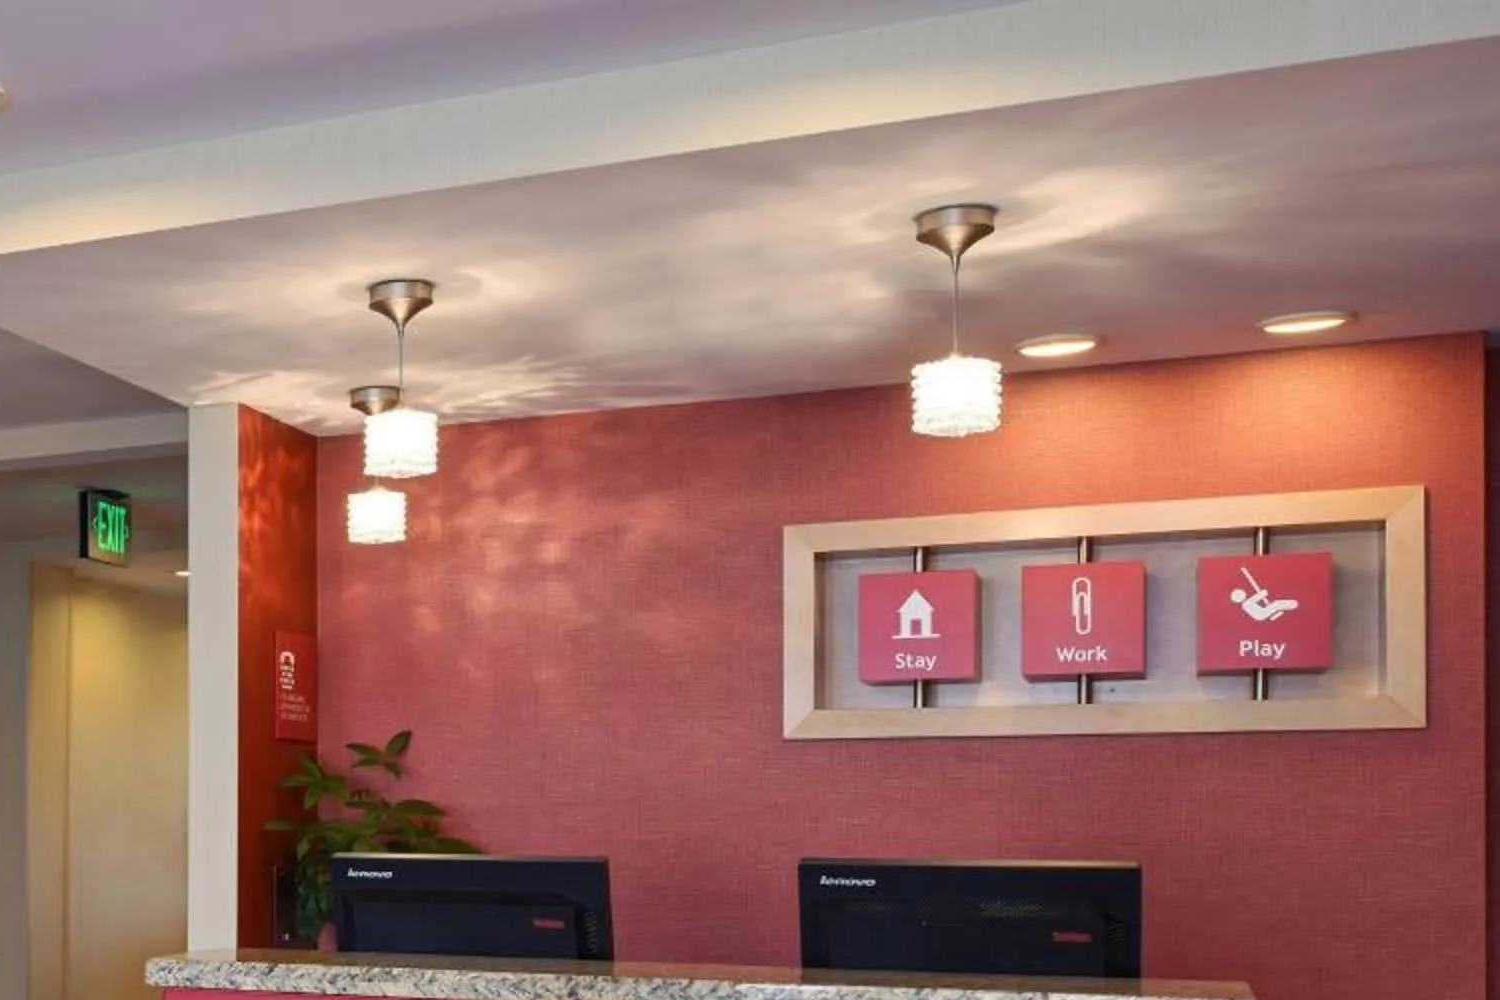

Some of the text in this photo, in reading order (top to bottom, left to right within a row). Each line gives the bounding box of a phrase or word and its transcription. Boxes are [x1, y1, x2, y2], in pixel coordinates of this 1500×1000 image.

[98, 501, 126, 554] EXIT
[1056, 645, 1108, 663] Work
[1239, 639, 1286, 660] Play
[895, 653, 937, 671] Stay
[347, 868, 393, 879] lenovo
[819, 875, 876, 888] lenovo
